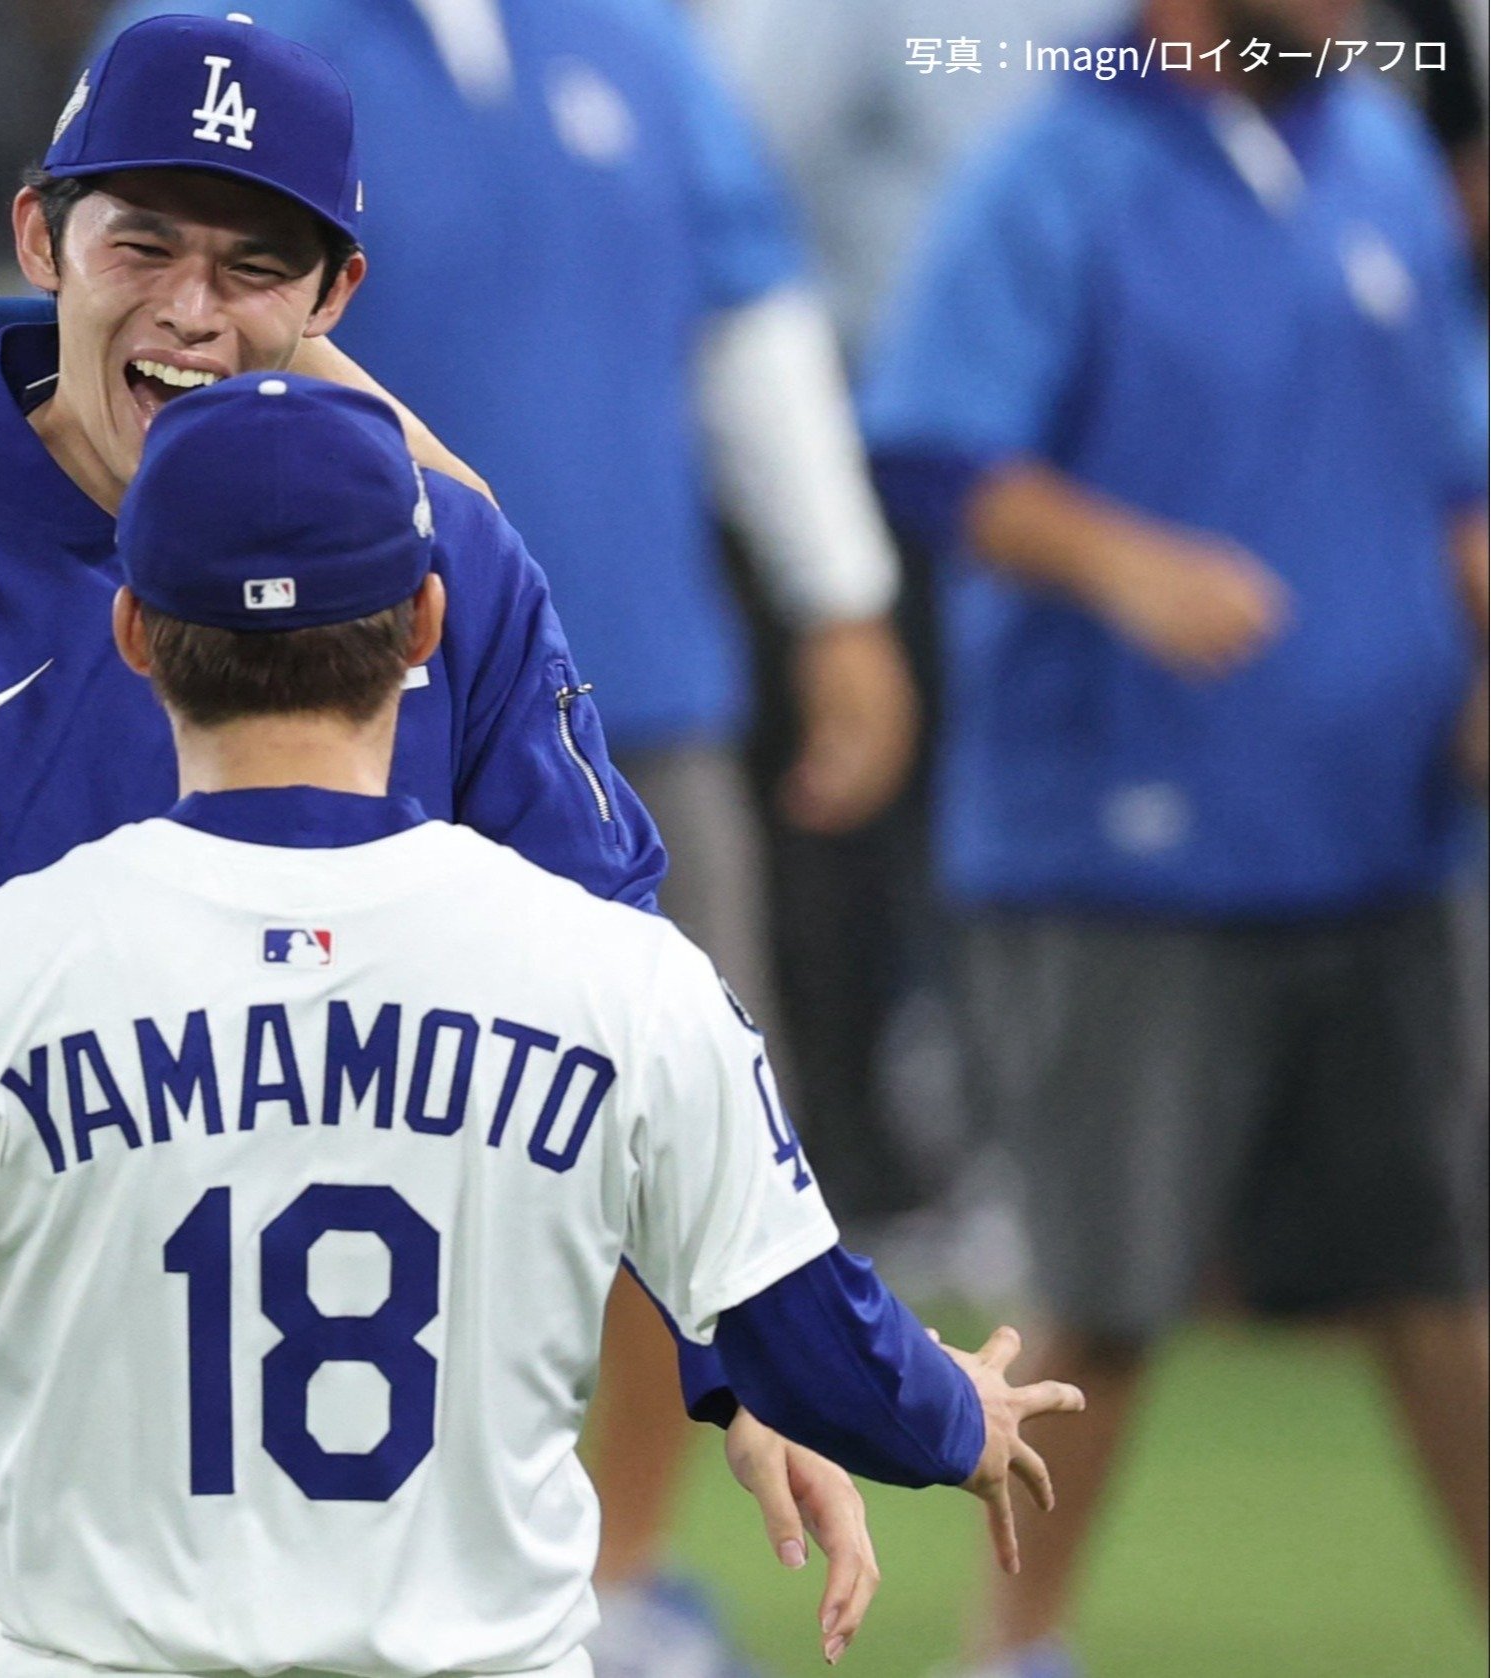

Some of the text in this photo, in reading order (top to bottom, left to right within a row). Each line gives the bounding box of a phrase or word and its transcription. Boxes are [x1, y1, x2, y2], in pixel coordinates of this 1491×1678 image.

[192, 54, 257, 151] LA
[0, 1000, 618, 1175] YAMAMOTO
[162, 1182, 442, 1503] 18
